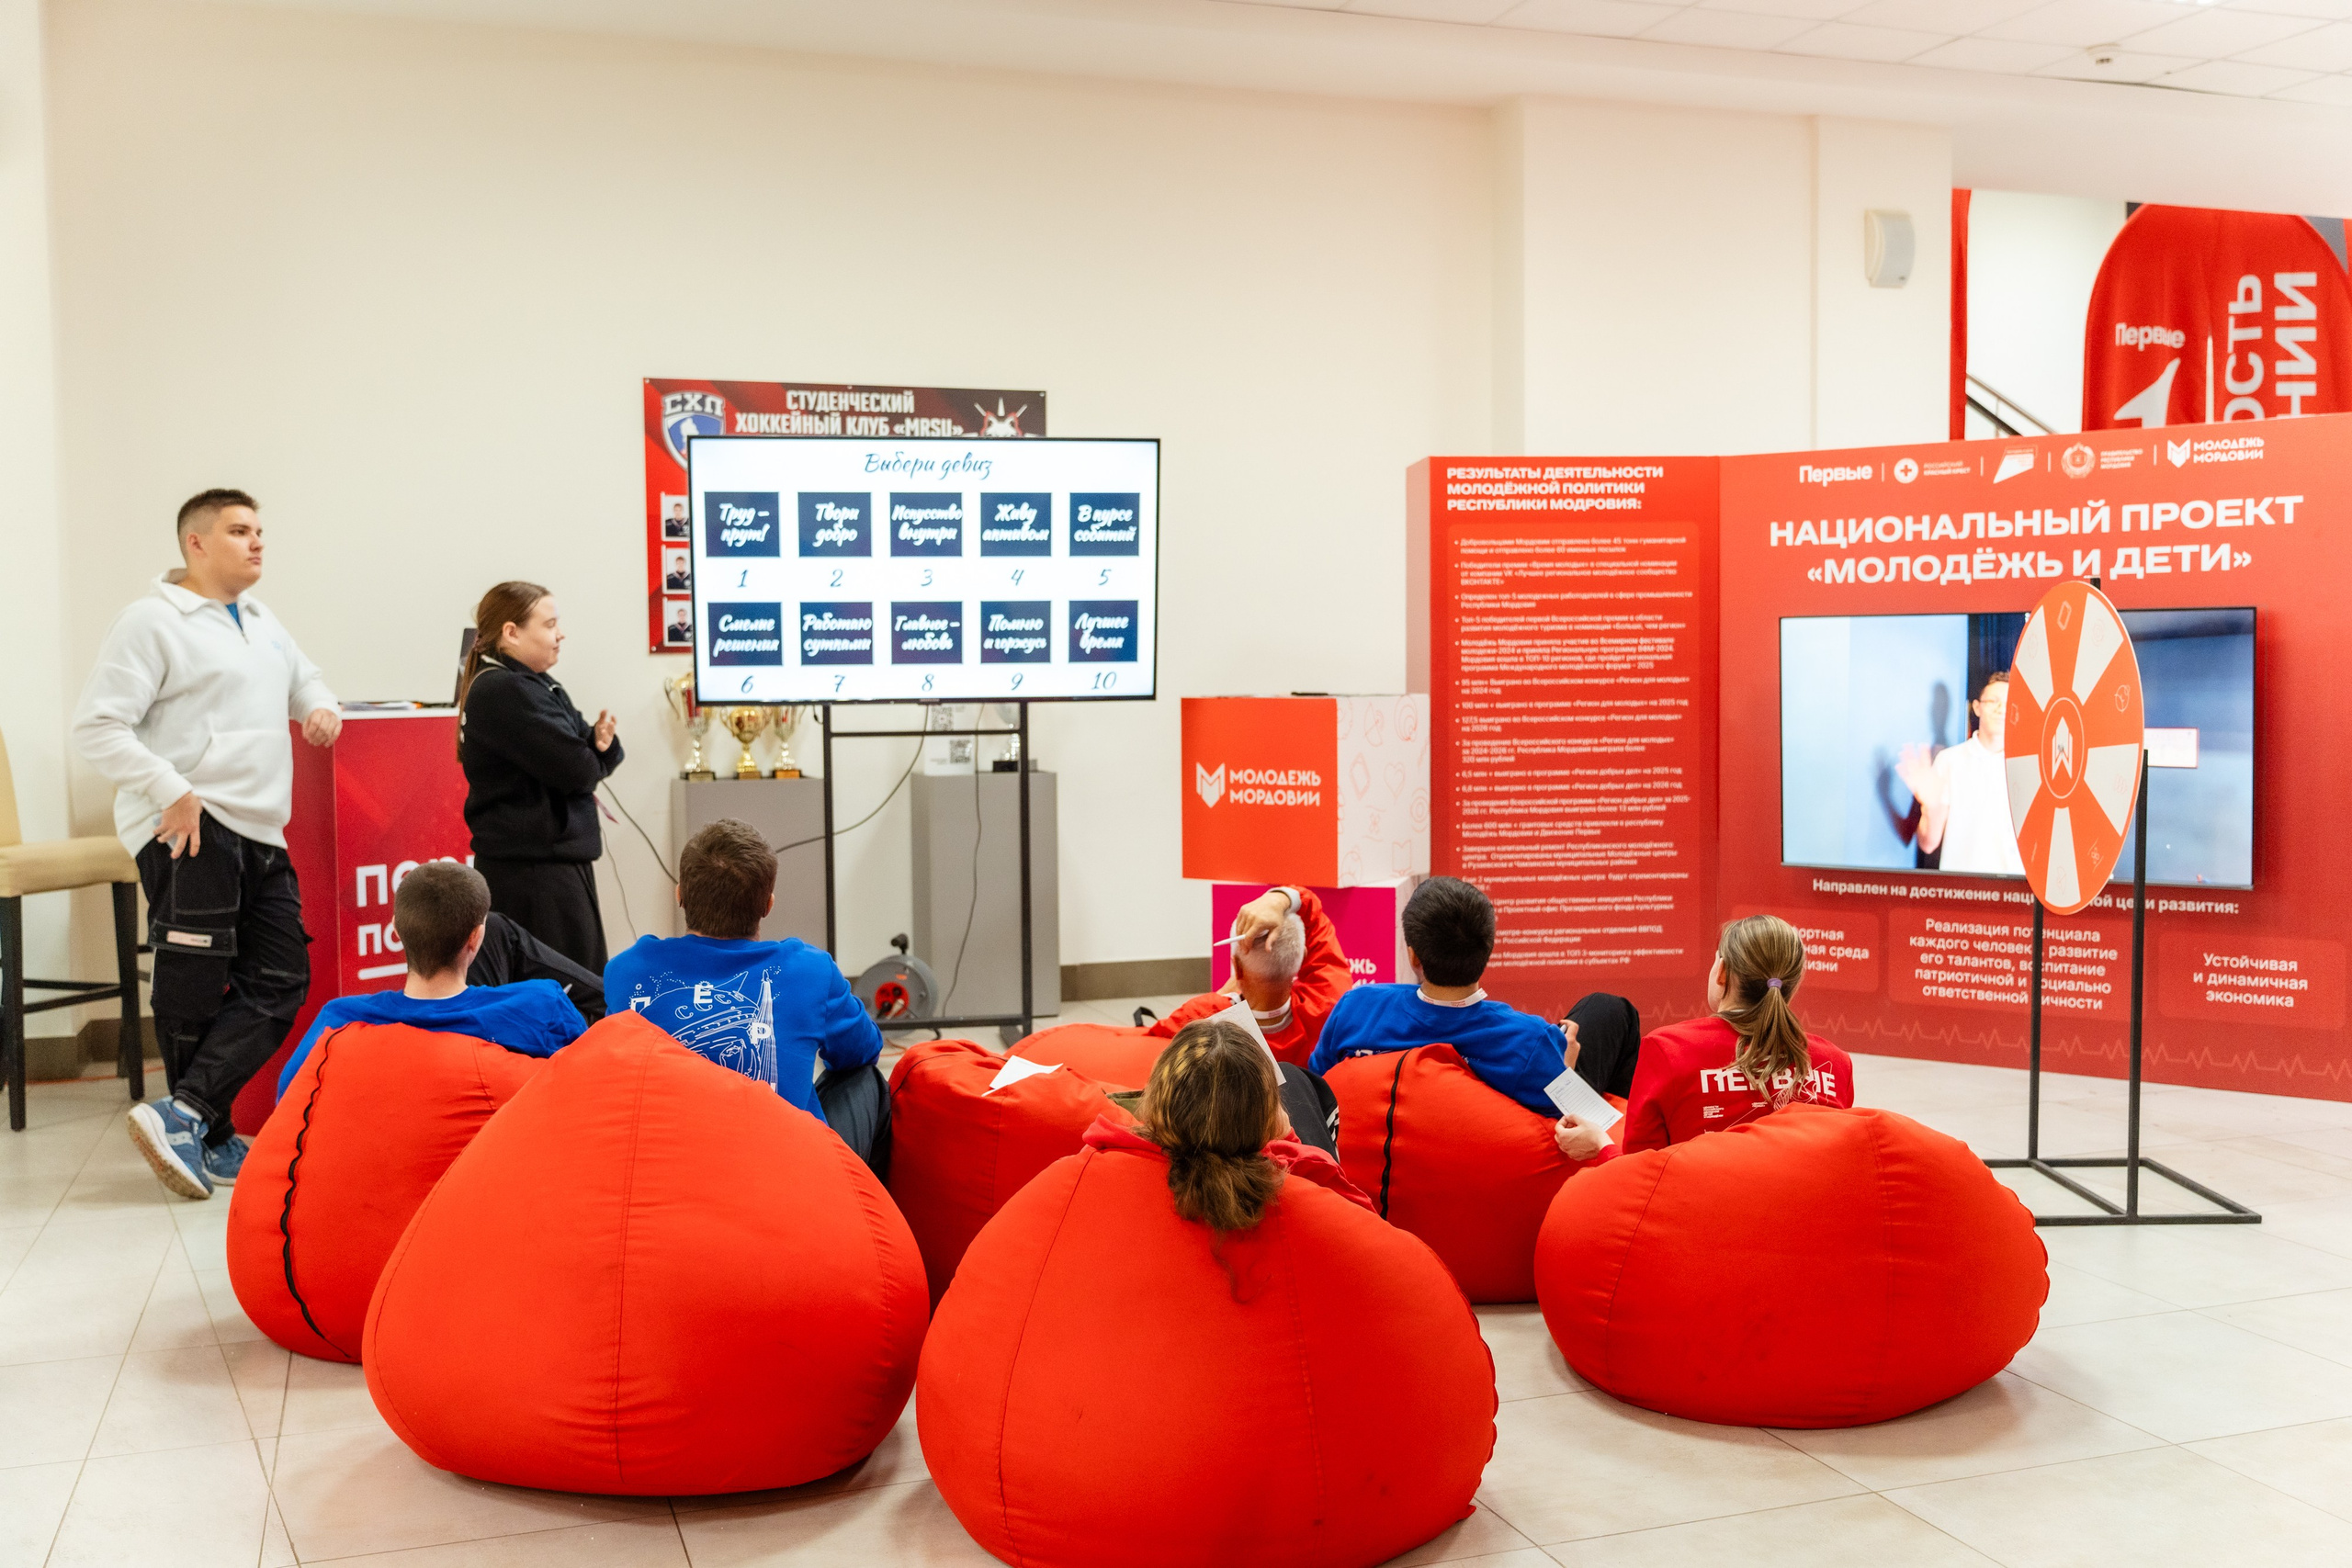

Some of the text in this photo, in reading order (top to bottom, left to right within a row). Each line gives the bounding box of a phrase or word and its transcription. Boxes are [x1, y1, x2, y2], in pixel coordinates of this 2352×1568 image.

[2116, 322, 2185, 351] Первые
[784, 387, 914, 416] СТУДЕНЧЕСКИЙ
[736, 413, 841, 434] ХОККЕЙНЫЙ
[846, 416, 889, 435] КЛУБ
[2194, 437, 2264, 451] МОЛОДЕЖЬ
[2194, 448, 2263, 463] МОРДОВИИ
[865, 452, 991, 479] Выбери девиз
[1447, 467, 1663, 479] РЕЗУЛЬТАТЫ ДЕЯТЕЛЬНОСТИ
[1800, 466, 1872, 487] Первые
[1448, 481, 1645, 496] МОЛОДЁЖНОЙ ПОЛИТИКИ
[816, 502, 859, 521] Твори
[995, 502, 1037, 523] Живу
[1078, 505, 1094, 522] В
[1448, 498, 1641, 511] РЕСПУБЛИКИ МОДРОВИЯ:
[720, 503, 755, 525] Труд
[1770, 495, 2303, 550] НАЦИОНАЛЬНЫЙ ПРОЕКТ
[813, 521, 857, 547] добро
[899, 524, 957, 546] внутри
[1074, 523, 1136, 541] событий
[1808, 544, 2251, 585] «МОЛОДЁЖЬ И ДЕТИ»
[739, 570, 747, 587] 1
[831, 570, 842, 587] 2
[922, 570, 932, 586] 3
[1012, 570, 1023, 585] 4
[1099, 570, 1111, 585] 5
[741, 676, 752, 692] 6
[835, 675, 844, 692] 7
[922, 675, 933, 690] 8
[1012, 674, 1023, 690] 9
[1093, 672, 1116, 689] 10
[1230, 769, 1320, 786] МОЛОДЕЖЬ
[1230, 789, 1319, 806] МОРДОВИИ
[1813, 878, 1887, 895] Направлен
[1890, 885, 1907, 897] на
[1909, 886, 1999, 901] достижение
[2116, 898, 2155, 910] цеи
[2158, 899, 2239, 915] развития:
[1925, 918, 2101, 943] Реализация поенциала
[1828, 945, 1870, 960] среда
[1909, 935, 2118, 961] каждого человек, развитие
[1345, 958, 1377, 975] ЖЬ
[1920, 953, 2106, 976] его талантов, вопитание
[2203, 953, 2297, 972] Устойчивая
[1915, 967, 2112, 994] патриотичной и оциально
[2193, 972, 2308, 990] и динамичная
[1922, 987, 2103, 1010] ответственной ичности
[2206, 990, 2293, 1008] экономика
